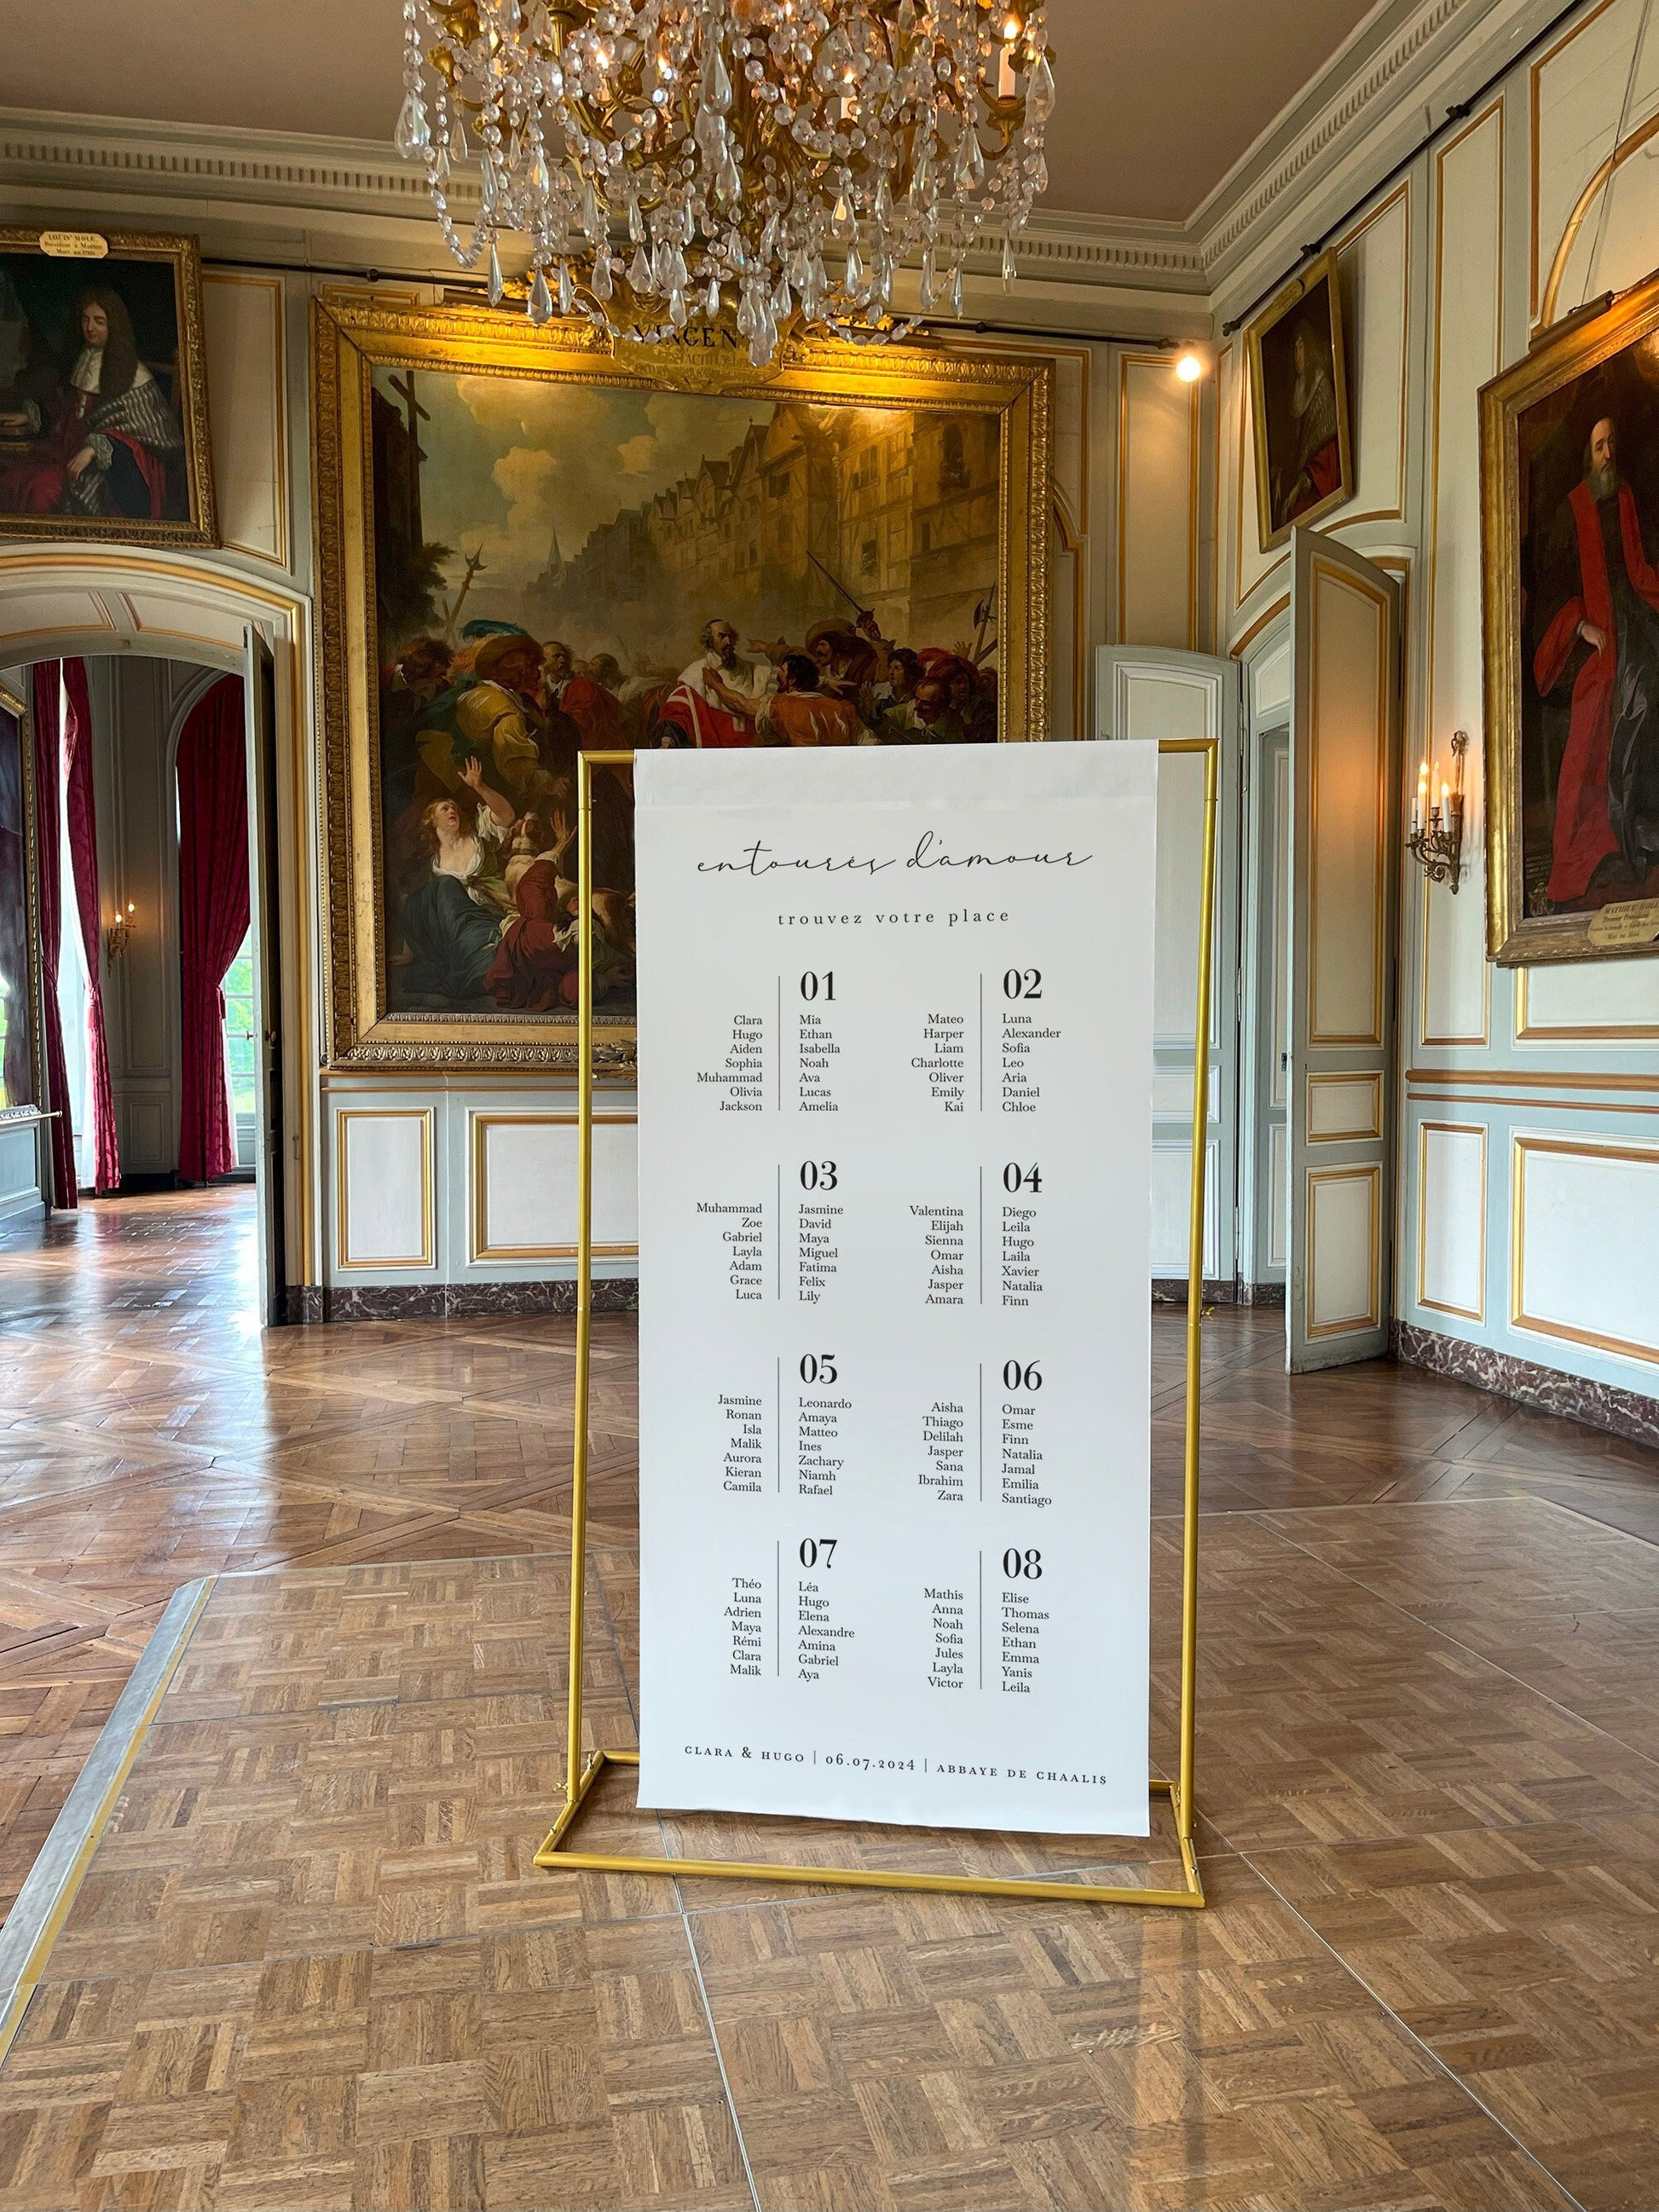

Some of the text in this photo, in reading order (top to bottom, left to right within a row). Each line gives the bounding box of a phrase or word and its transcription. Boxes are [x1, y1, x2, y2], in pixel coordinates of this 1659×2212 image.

[633, 324, 747, 349] VINCEN
[697, 831, 1093, 875] entourés d'amour
[777, 908, 1009, 927] trouvez votre place
[801, 971, 835, 1001] 01
[1003, 968, 1042, 999] 02
[734, 1015, 762, 1025] Clara
[800, 1014, 821, 1025] Mia
[928, 1014, 963, 1024] Mateo
[1003, 1014, 1032, 1024] Luna
[732, 1030, 762, 1042] Hugo
[800, 1029, 832, 1039] Ethan
[924, 1028, 964, 1042] Harper
[1002, 1028, 1061, 1038] Alexander
[730, 1043, 762, 1054] Aiden
[800, 1043, 841, 1054] Isabella
[934, 1042, 963, 1054] Liam
[1003, 1042, 1030, 1054] Sofia
[725, 1058, 762, 1071] Sophia
[800, 1058, 829, 1068] Noah
[911, 1057, 963, 1068] Charlotte
[1003, 1057, 1024, 1068] Leo
[697, 1072, 762, 1083] Muhammad
[799, 1072, 821, 1083] Ava
[929, 1071, 964, 1083] Oliver
[1002, 1072, 1027, 1083] Aria
[730, 1086, 762, 1098] Olivia
[800, 1087, 831, 1097] Lucas
[931, 1087, 964, 1100] Emily
[1003, 1087, 1039, 1097] Daniel
[720, 1100, 762, 1111] Jackson
[799, 1101, 838, 1112] Amelia
[945, 1101, 963, 1112] Kai
[1003, 1101, 1036, 1112] Chloe
[801, 1160, 837, 1191] 03
[1003, 1162, 1042, 1193] 04
[697, 1203, 762, 1214] Muhammad
[799, 1204, 843, 1215] Jasmine
[910, 1205, 963, 1216] Valentina
[1003, 1206, 1037, 1221] Diego
[741, 1217, 762, 1229] Zoe
[800, 1218, 831, 1229] David
[931, 1220, 963, 1233] Elijah
[1003, 1221, 1031, 1232] Leila
[723, 1231, 762, 1242] Gabriel
[800, 1233, 830, 1246] Maya
[925, 1234, 963, 1245] Sienna
[1003, 1236, 1034, 1250] Hugo
[732, 1246, 762, 1259] Layla
[800, 1247, 838, 1261] Miguel
[930, 1249, 963, 1261] Omar
[1003, 1250, 1031, 1262] Laila
[729, 1261, 762, 1271] Adam
[800, 1262, 836, 1273] Fatima
[931, 1264, 963, 1275] Aisha
[1002, 1265, 1039, 1277] Xavier
[730, 1274, 762, 1285] Grace
[799, 1276, 825, 1286] Felix
[928, 1279, 963, 1292] Jasper
[1003, 1280, 1043, 1291] Natalia
[736, 1290, 762, 1300] Luca
[799, 1290, 820, 1304] Lily
[925, 1294, 963, 1304] Amara
[1003, 1295, 1028, 1306] Finn
[800, 1354, 837, 1384] 05
[1003, 1360, 1042, 1391] 06
[718, 1395, 762, 1406] Jasmine
[799, 1397, 852, 1409] Leonardo
[931, 1402, 963, 1412] Aisha
[1003, 1404, 1036, 1416] Omar
[725, 1408, 761, 1420] Ronan
[798, 1412, 837, 1426] Amaya
[922, 1416, 963, 1429] Thiago
[1003, 1418, 1033, 1430] Esme
[743, 1424, 762, 1435] Isla
[799, 1426, 837, 1438] Matteo
[923, 1430, 963, 1442] Delilah
[1003, 1434, 1029, 1445] Finn
[731, 1438, 762, 1450] Malik
[799, 1441, 822, 1452] Ines
[723, 1453, 761, 1465] Aurora
[928, 1446, 963, 1460] Jasper
[1003, 1448, 1043, 1460] Natalia
[799, 1455, 844, 1470] Zachary
[936, 1460, 963, 1472] Sana
[725, 1466, 761, 1478] Kieran
[1002, 1463, 1035, 1475] Jamal
[799, 1470, 836, 1481] Niamh
[918, 1475, 963, 1487] Ibrahim
[723, 1480, 761, 1493] Camila
[799, 1484, 833, 1495] Rafael
[1003, 1478, 1039, 1489] Emilia
[938, 1490, 963, 1501] Zara
[1002, 1493, 1051, 1508] Santiago
[800, 1538, 837, 1568] 07
[1003, 1548, 1042, 1580] 08
[731, 1578, 761, 1589] Théo
[799, 1581, 818, 1592] Léa
[733, 1591, 761, 1603] Luna
[924, 1588, 963, 1600] Mathis
[1003, 1592, 1029, 1603] Elise
[799, 1596, 830, 1610] Hugo
[932, 1603, 963, 1615] Anna
[724, 1607, 761, 1618] Adrien
[799, 1610, 830, 1622] Elena
[1001, 1607, 1049, 1620] Thomas
[731, 1620, 761, 1635] Maya
[933, 1618, 963, 1630] Noah
[1002, 1622, 1039, 1634] Selena
[798, 1625, 854, 1637] Alexandre
[732, 1635, 761, 1647] Rémi
[935, 1632, 963, 1644] Sofia
[1003, 1637, 1037, 1649] Ethan
[798, 1639, 835, 1651] Amina
[731, 1649, 761, 1661] Clara
[935, 1647, 963, 1659] Jules
[1003, 1651, 1039, 1664] Emma
[799, 1654, 839, 1666] Gabriel
[730, 1664, 761, 1676] Malik
[798, 1668, 819, 1682] Aya
[933, 1662, 963, 1677] Layla
[1002, 1666, 1032, 1678] Yanis
[928, 1677, 963, 1689] Victor
[1003, 1681, 1030, 1693] Leila
[684, 1745, 1107, 1786] CLARA & HUGO 06.07.2024 ABBAYE DE CHAALIS
